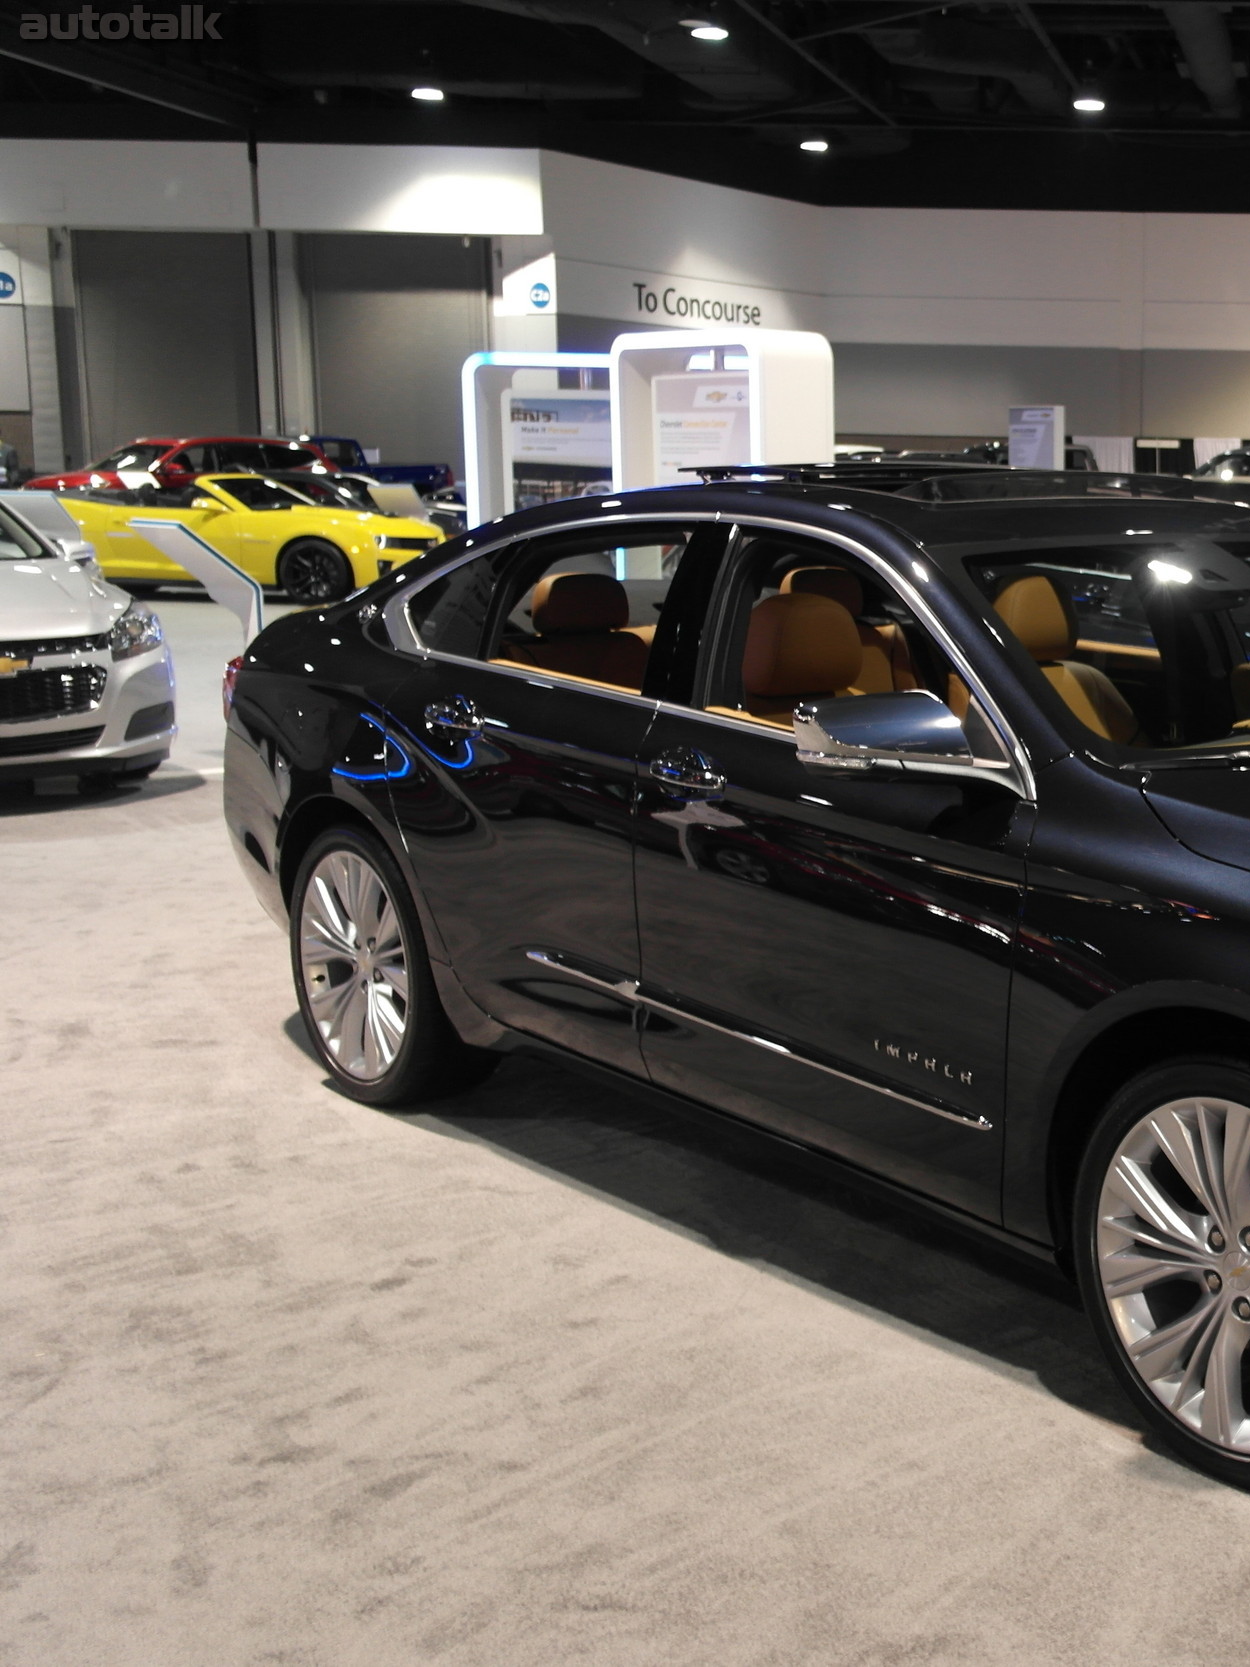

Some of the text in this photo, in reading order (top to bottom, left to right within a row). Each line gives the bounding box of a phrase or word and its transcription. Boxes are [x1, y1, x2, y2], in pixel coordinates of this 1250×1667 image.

[633, 282, 762, 326] To Concourse
[874, 1039, 972, 1086] IMPALA
